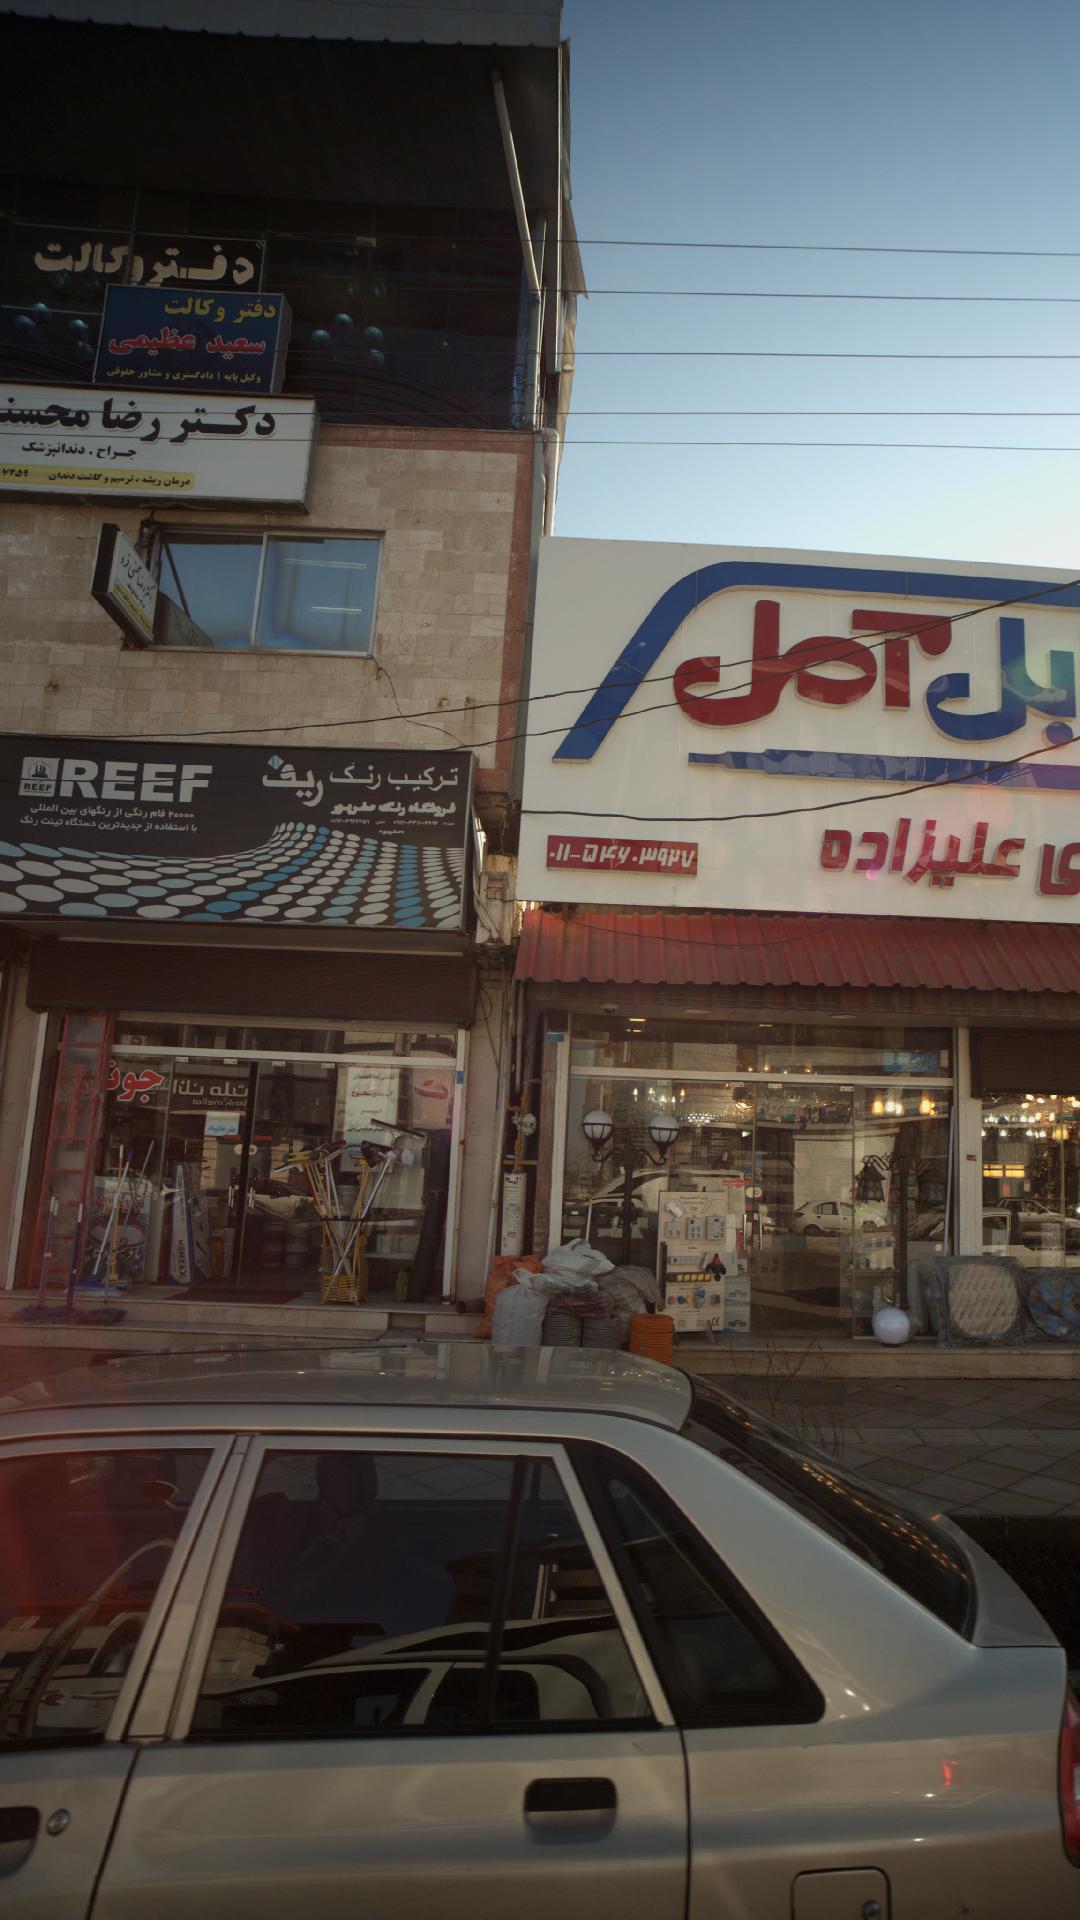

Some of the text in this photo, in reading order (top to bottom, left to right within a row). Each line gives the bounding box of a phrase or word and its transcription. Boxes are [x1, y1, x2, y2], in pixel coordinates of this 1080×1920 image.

[34, 240, 255, 286] دفتر وکالت
[212, 306, 225, 323] و
[232, 298, 277, 323] دفتر
[107, 326, 267, 360] سعید عظیمی
[105, 366, 135, 377] حقوقی
[138, 369, 162, 380] مشاور
[172, 370, 214, 380] دادگستری
[240, 373, 261, 384] وکیل
[102, 397, 160, 442] رضا
[169, 405, 276, 443] دکتر
[22, 442, 137, 460] جراح دندانپزشک
[48, 472, 75, 481] دندان
[77, 472, 102, 481] کاشت
[111, 475, 134, 484] ترمیم
[142, 476, 161, 487] ریشه
[163, 476, 190, 487] درمان
[673, 599, 951, 729] آمل
[24, 782, 52, 792] REEF
[59, 758, 214, 803] REEF
[262, 754, 459, 807] ترکیب رنگ ریف
[30, 803, 58, 814] المللی
[60, 806, 77, 816] بین
[79, 805, 111, 818] رنگهای
[113, 807, 122, 818] از
[125, 806, 148, 819] رنگی
[150, 808, 166, 819] فام
[378, 801, 406, 816] رنگ
[408, 801, 457, 817] فروشگاه
[19, 814, 198, 833] با استفاده از جدیدترین دستگاه تینت رنگ
[821, 817, 1026, 890] علیزاده
